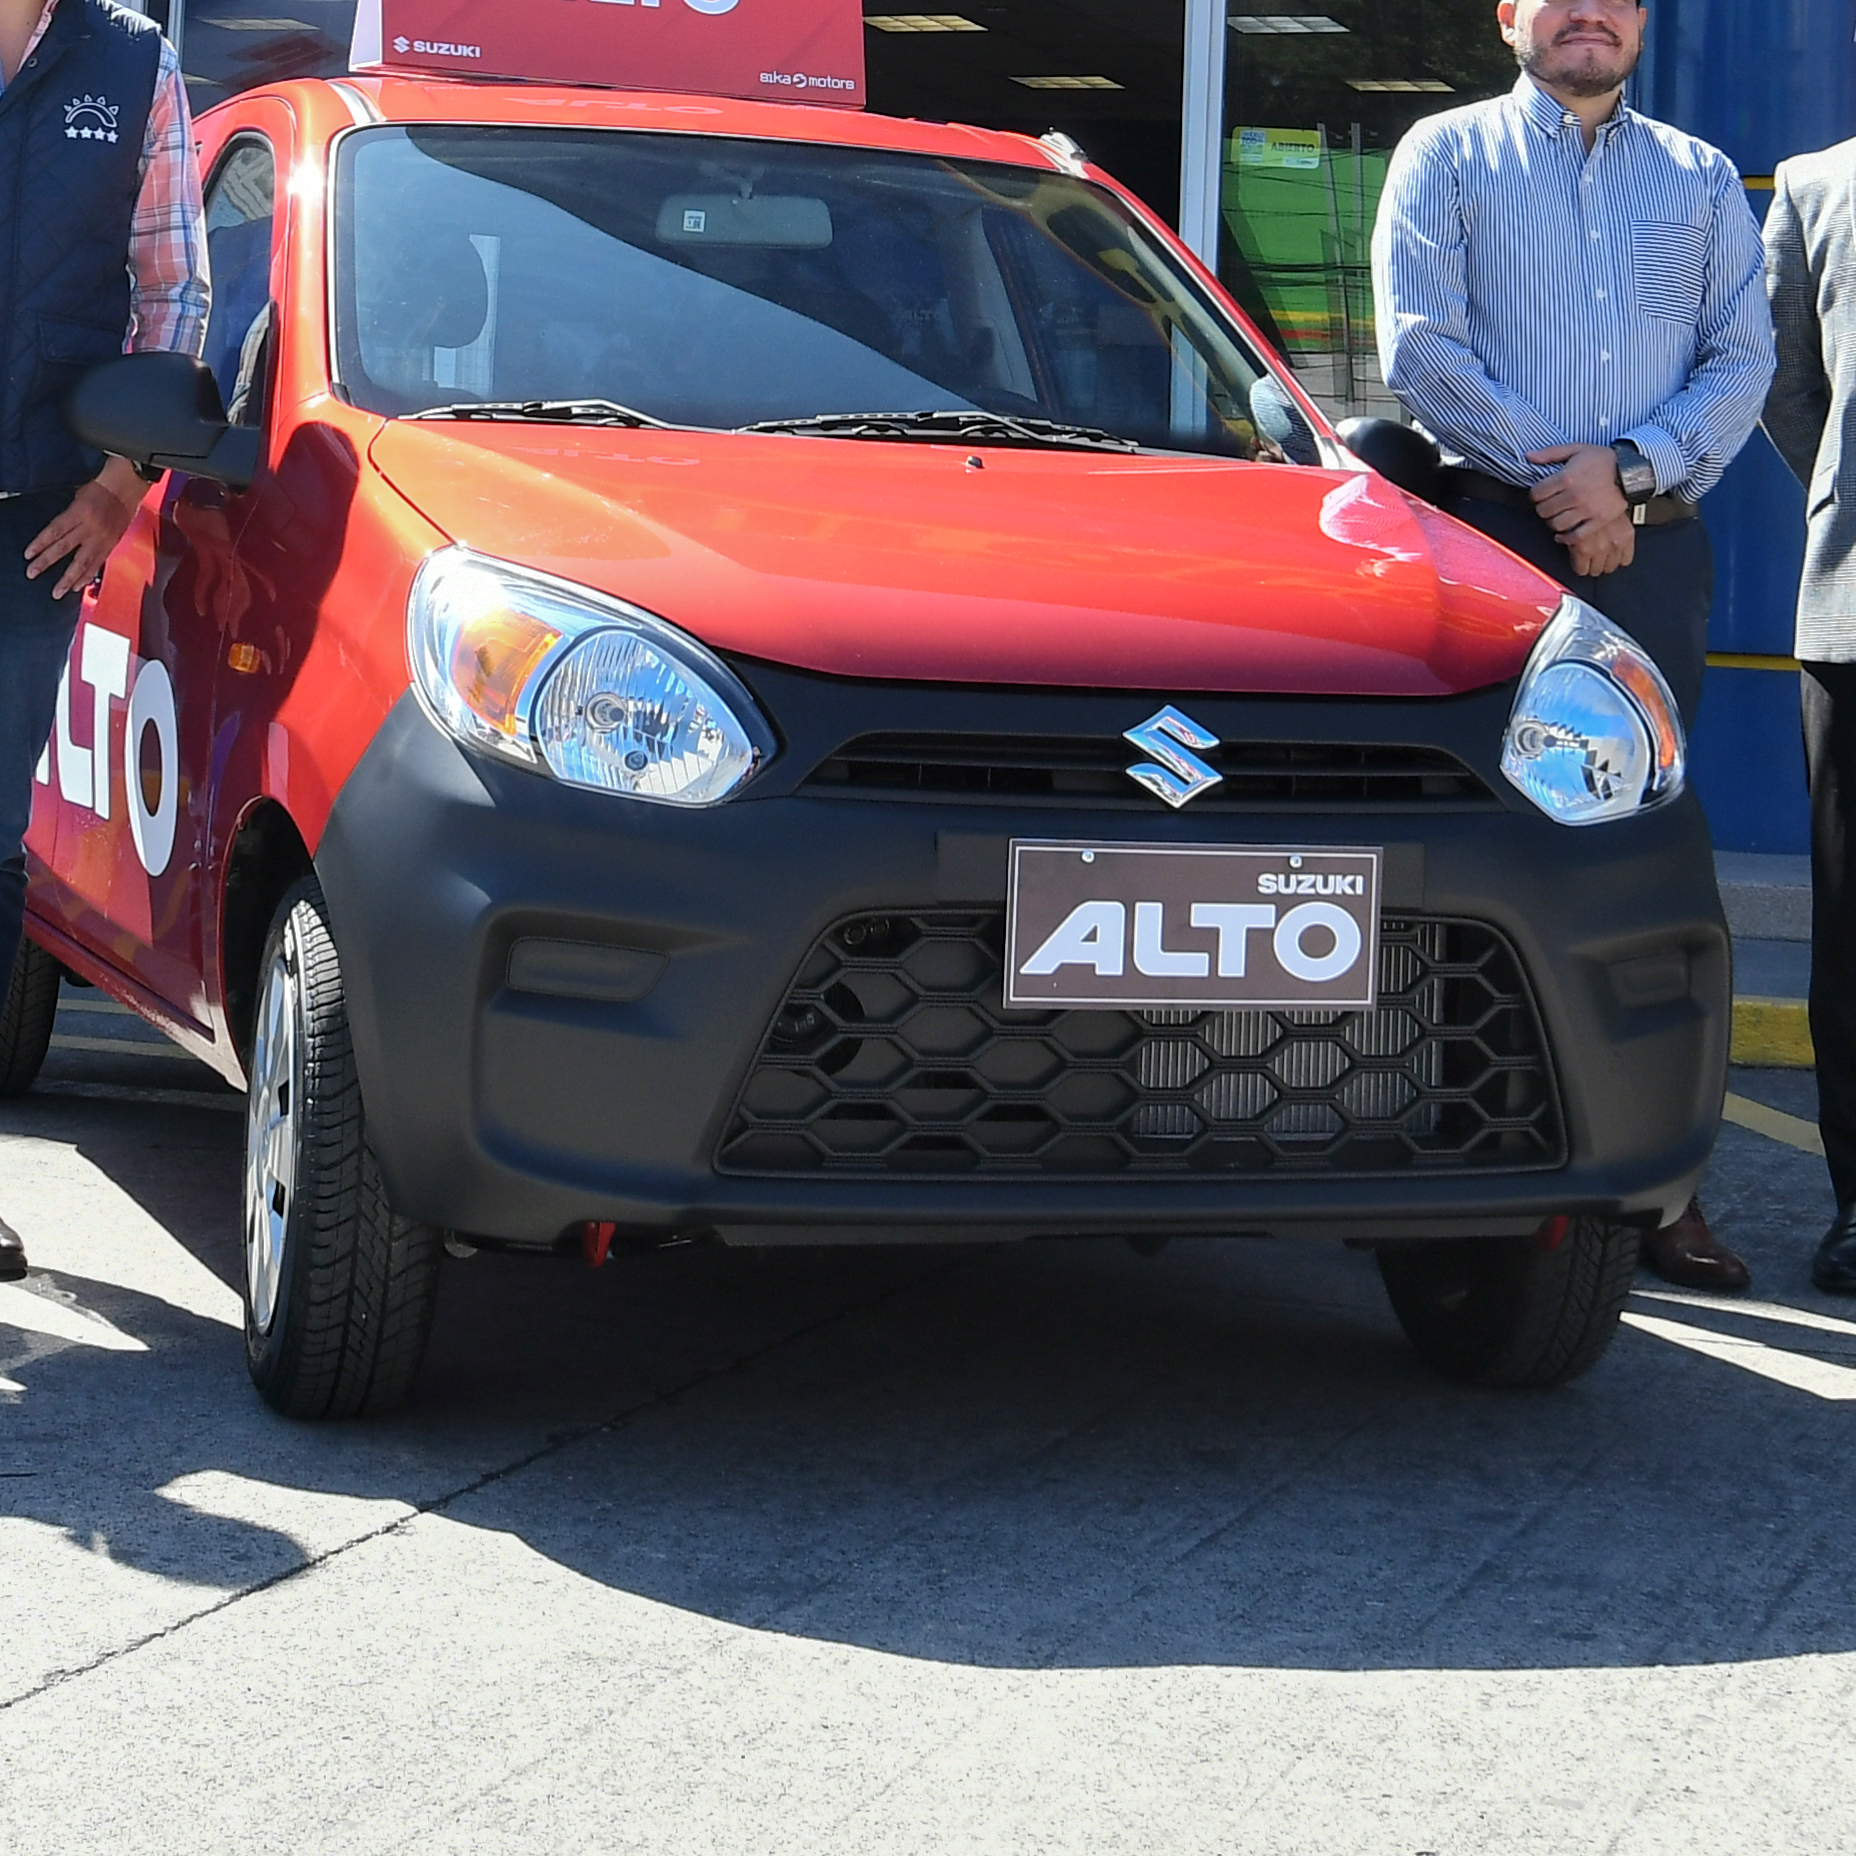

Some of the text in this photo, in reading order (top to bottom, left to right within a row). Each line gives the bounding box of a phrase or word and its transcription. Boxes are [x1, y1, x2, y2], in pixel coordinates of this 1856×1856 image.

[413, 40, 481, 58] SUZUKI
[808, 75, 855, 90] motors
[35, 622, 179, 877] LTO
[1257, 873, 1363, 895] SUZUKI
[1019, 901, 1362, 982] ALTO
